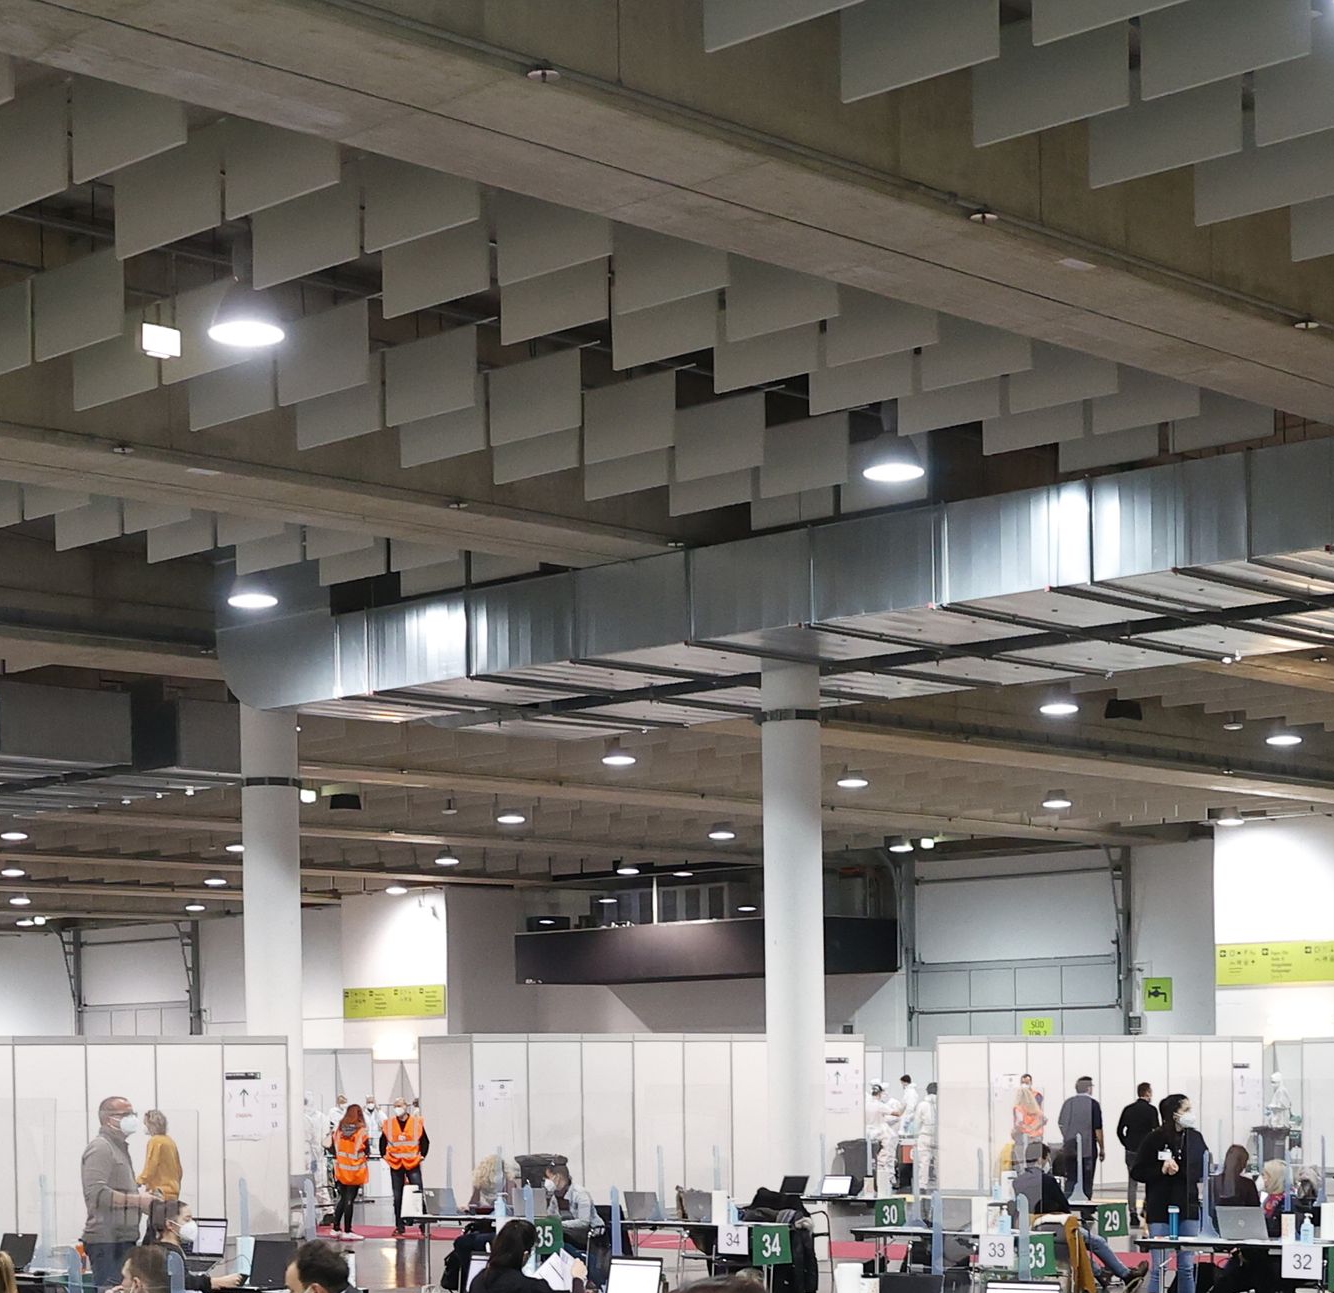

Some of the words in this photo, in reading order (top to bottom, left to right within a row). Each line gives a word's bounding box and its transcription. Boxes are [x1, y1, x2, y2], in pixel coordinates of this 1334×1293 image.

[882, 1204, 898, 1225] 30
[1104, 1210, 1120, 1231] 29
[726, 1232, 740, 1247] 34
[761, 1232, 782, 1258] 34
[988, 1242, 1006, 1258] 33
[1292, 1254, 1312, 1270] 32
